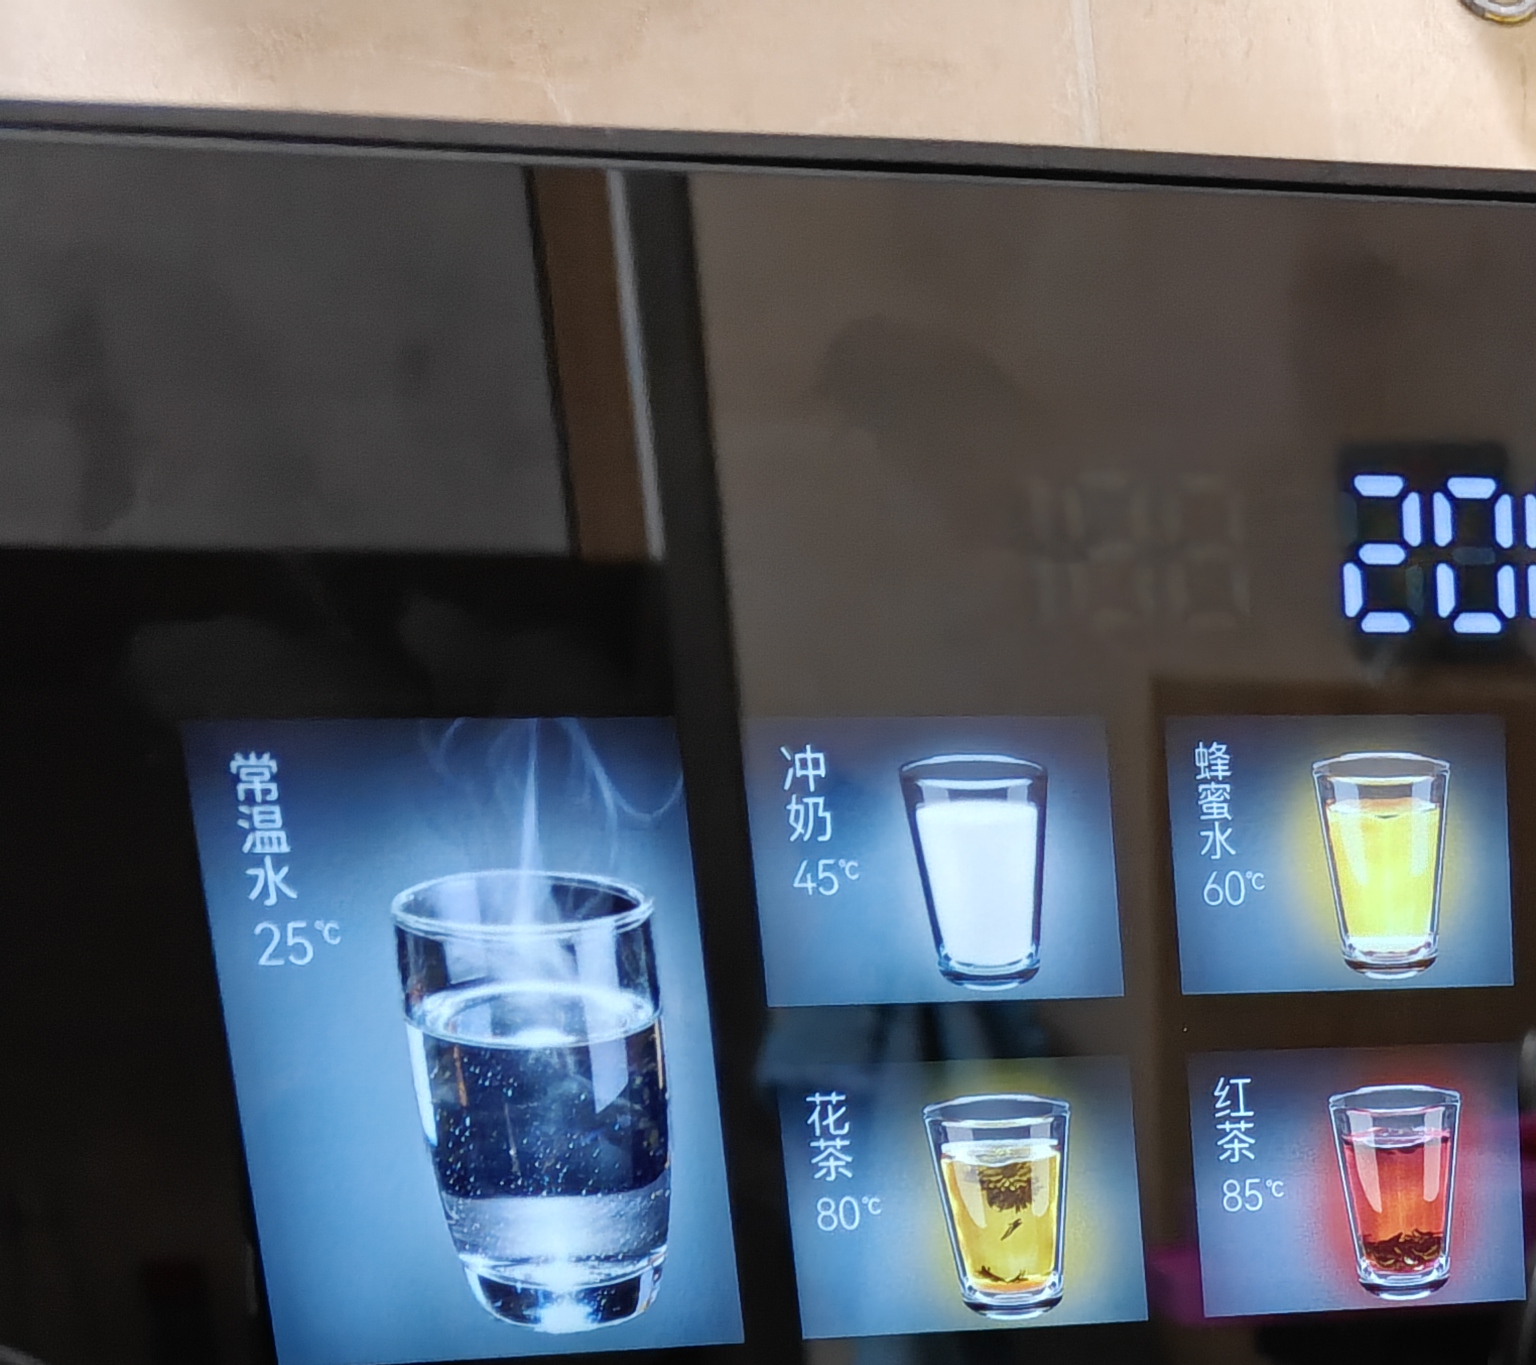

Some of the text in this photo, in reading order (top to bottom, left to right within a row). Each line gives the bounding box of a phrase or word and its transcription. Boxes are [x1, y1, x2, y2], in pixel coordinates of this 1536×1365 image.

[230, 751, 298, 906] 常温水
[780, 745, 832, 843] 冲奶
[1194, 741, 1237, 859] 蜂蜜水
[805, 1091, 853, 1181] 花茶
[1213, 1077, 1256, 1163] 红茶
